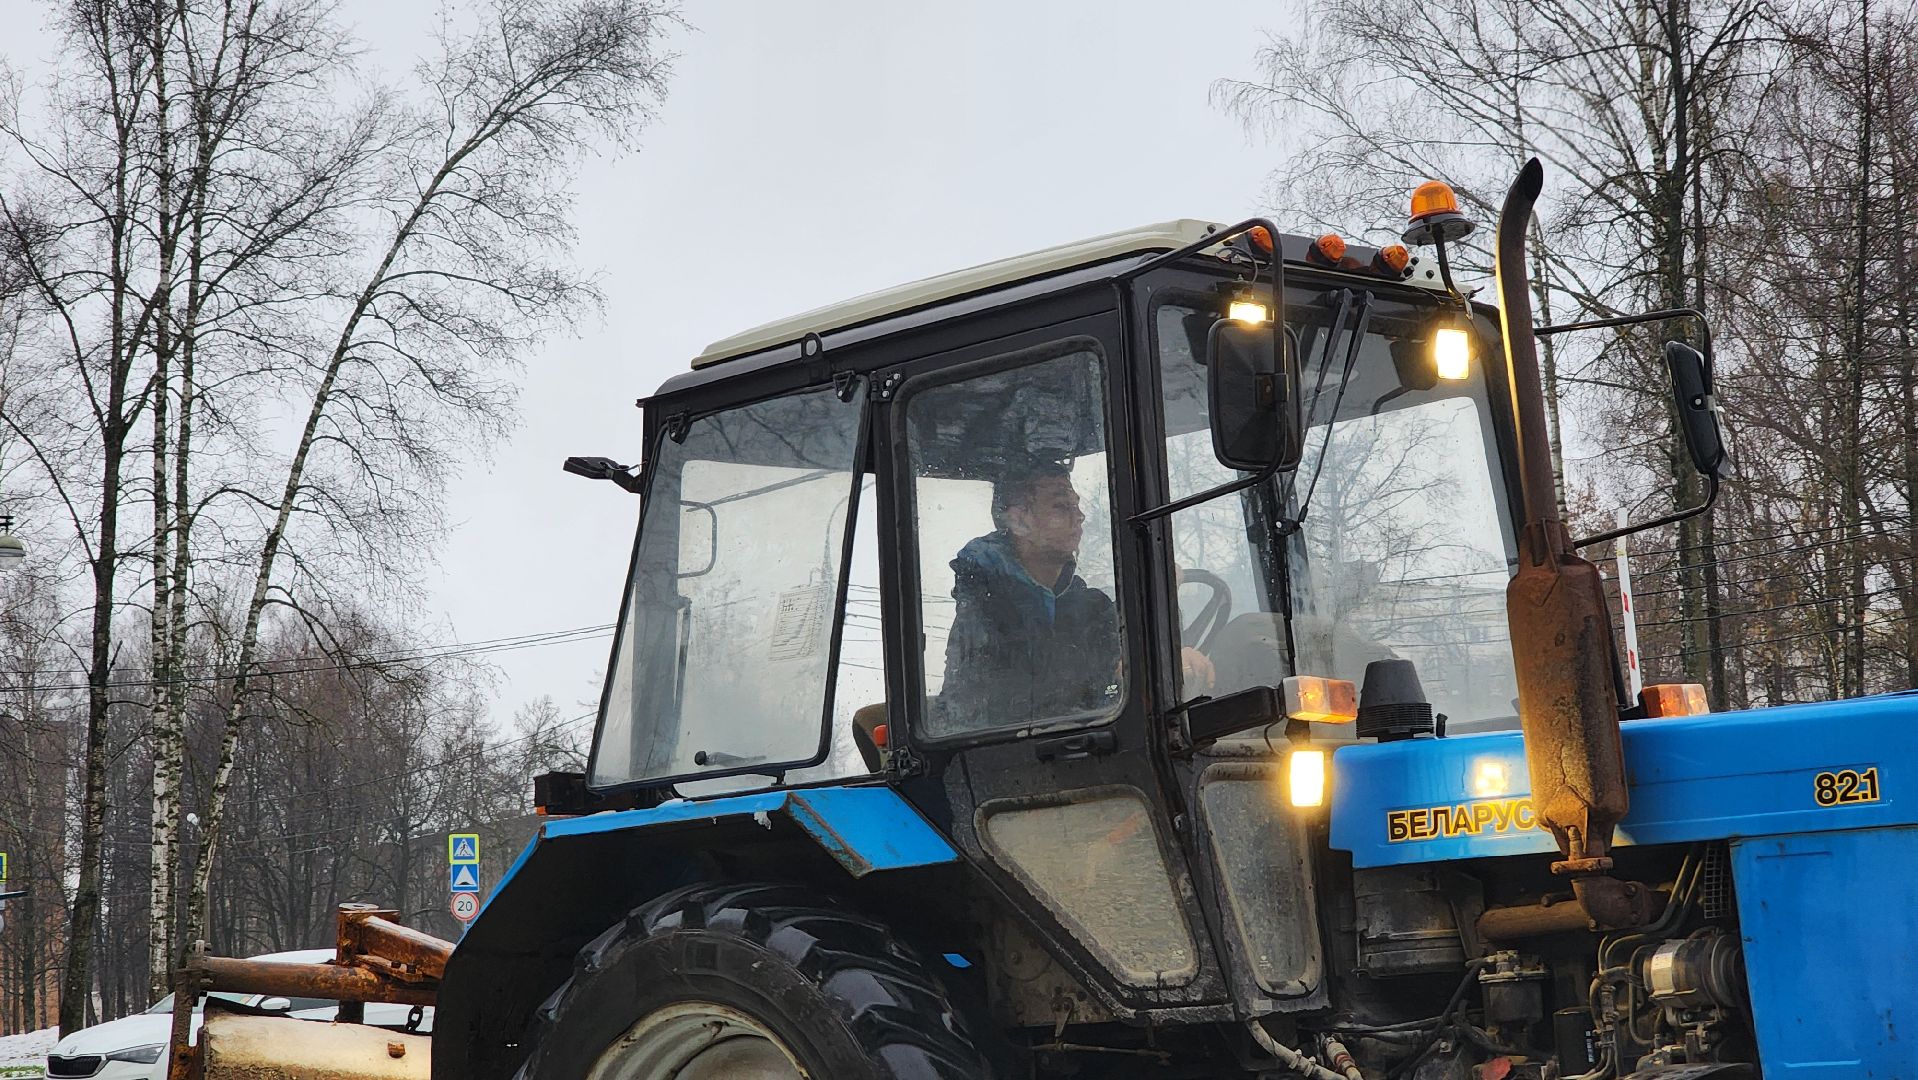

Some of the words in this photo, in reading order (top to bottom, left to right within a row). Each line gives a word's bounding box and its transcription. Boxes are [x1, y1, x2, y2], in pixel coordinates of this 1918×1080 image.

[1814, 767, 1880, 807] 82.1
[1387, 798, 1536, 843] БЕЛАРУС
[457, 900, 473, 912] 20
